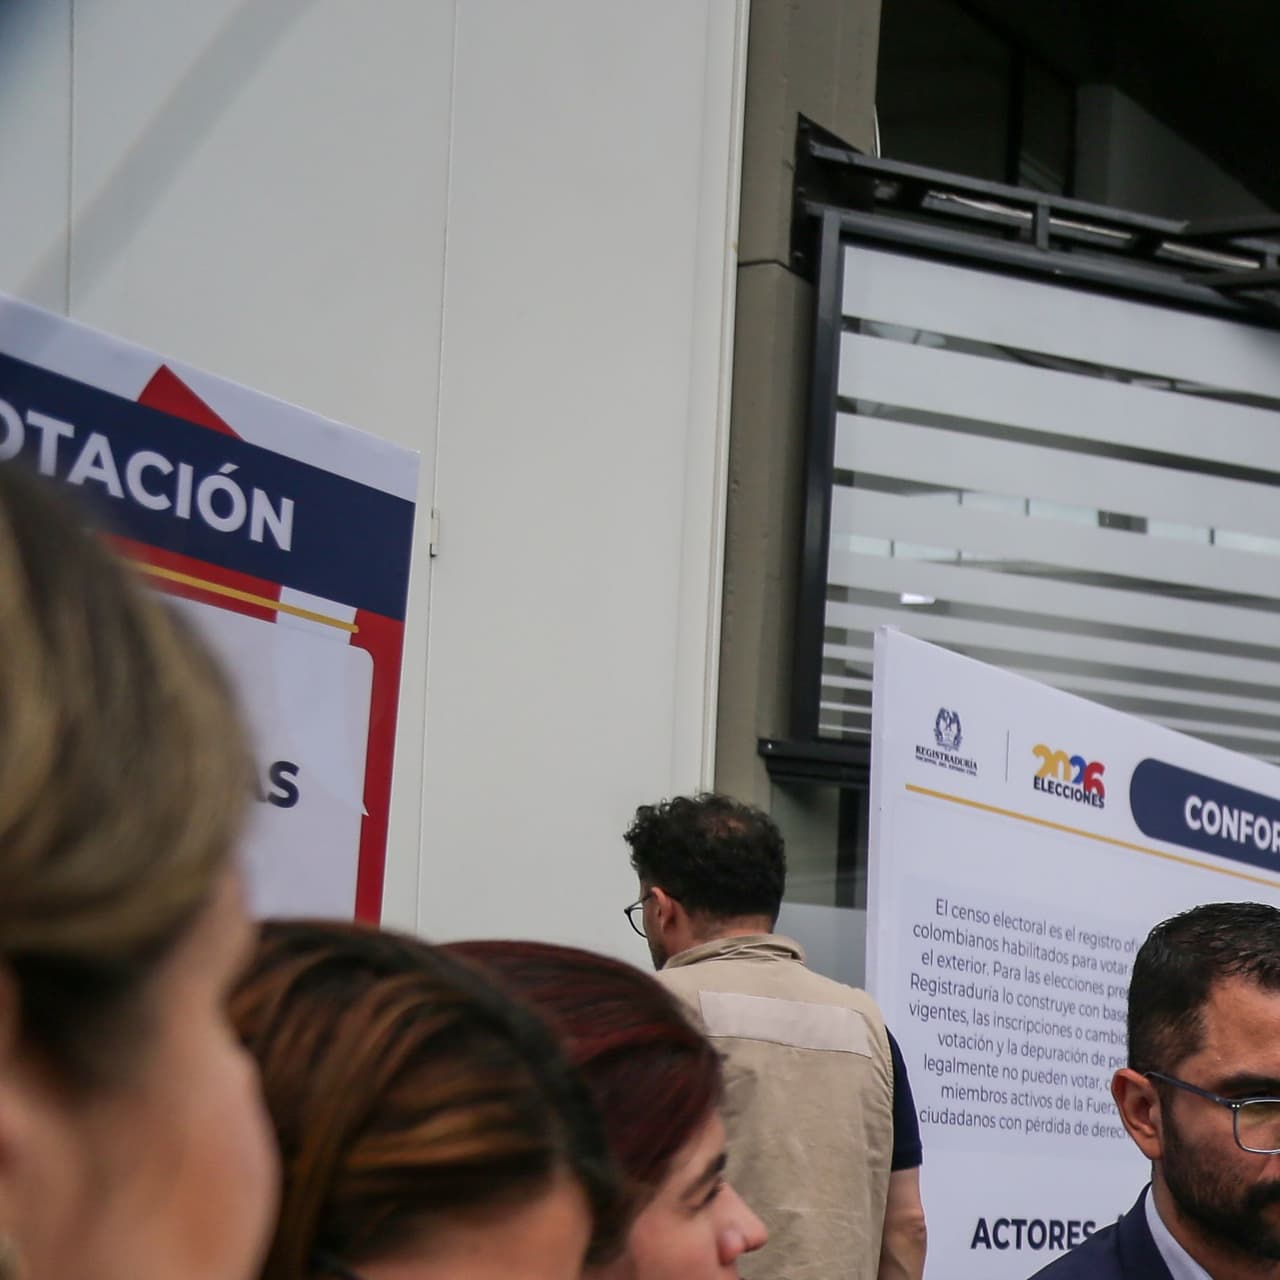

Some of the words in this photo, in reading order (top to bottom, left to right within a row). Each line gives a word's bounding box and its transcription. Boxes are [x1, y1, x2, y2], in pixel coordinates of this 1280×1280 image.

[1032, 744, 1105, 798] 2026
[1033, 775, 1105, 809] ELECCIONES
[935, 898, 948, 917] El
[951, 903, 990, 925] censo
[993, 911, 1047, 937] electoral
[1049, 924, 1063, 940] es
[1066, 927, 1076, 942] el
[1079, 930, 1122, 952] registro
[912, 923, 999, 952] colombianos
[1002, 937, 1070, 965] habilitados
[1072, 954, 1098, 971] para
[1100, 958, 1129, 976] votar
[921, 950, 934, 967] el
[936, 954, 990, 977] exterior.
[993, 962, 1022, 981] Para
[1025, 966, 1041, 985] las
[1043, 971, 1105, 996] elecciones
[1108, 983, 1129, 1000] pre
[908, 1000, 969, 1026] vigentes,
[972, 1008, 990, 1027] las
[993, 1010, 1073, 1038] inscripciones
[1075, 1027, 1083, 1040] o
[1002, 987, 1014, 1006] lo
[1017, 993, 1076, 1015] construye
[1079, 1002, 1100, 1017] con
[937, 1032, 994, 1053] votación
[997, 1040, 1005, 1057] y
[1007, 1038, 1018, 1055] la
[1021, 1041, 1089, 1064] depuración
[1091, 1051, 1106, 1067] de
[924, 1053, 999, 1078] legalmente
[1002, 1066, 1019, 1081] no
[1021, 1067, 1068, 1086] pueden
[1070, 1074, 1103, 1092] votar,
[941, 1083, 1008, 1105] miembros
[1010, 1091, 1053, 1109] activos
[1055, 1096, 1071, 1110] de
[1074, 1096, 1084, 1112] la
[1086, 1097, 1118, 1116] Fuerz
[919, 1107, 996, 1129] ciudadanos
[999, 1115, 1022, 1131] con
[1025, 1116, 1071, 1135] pérdida
[1074, 1120, 1089, 1136] de
